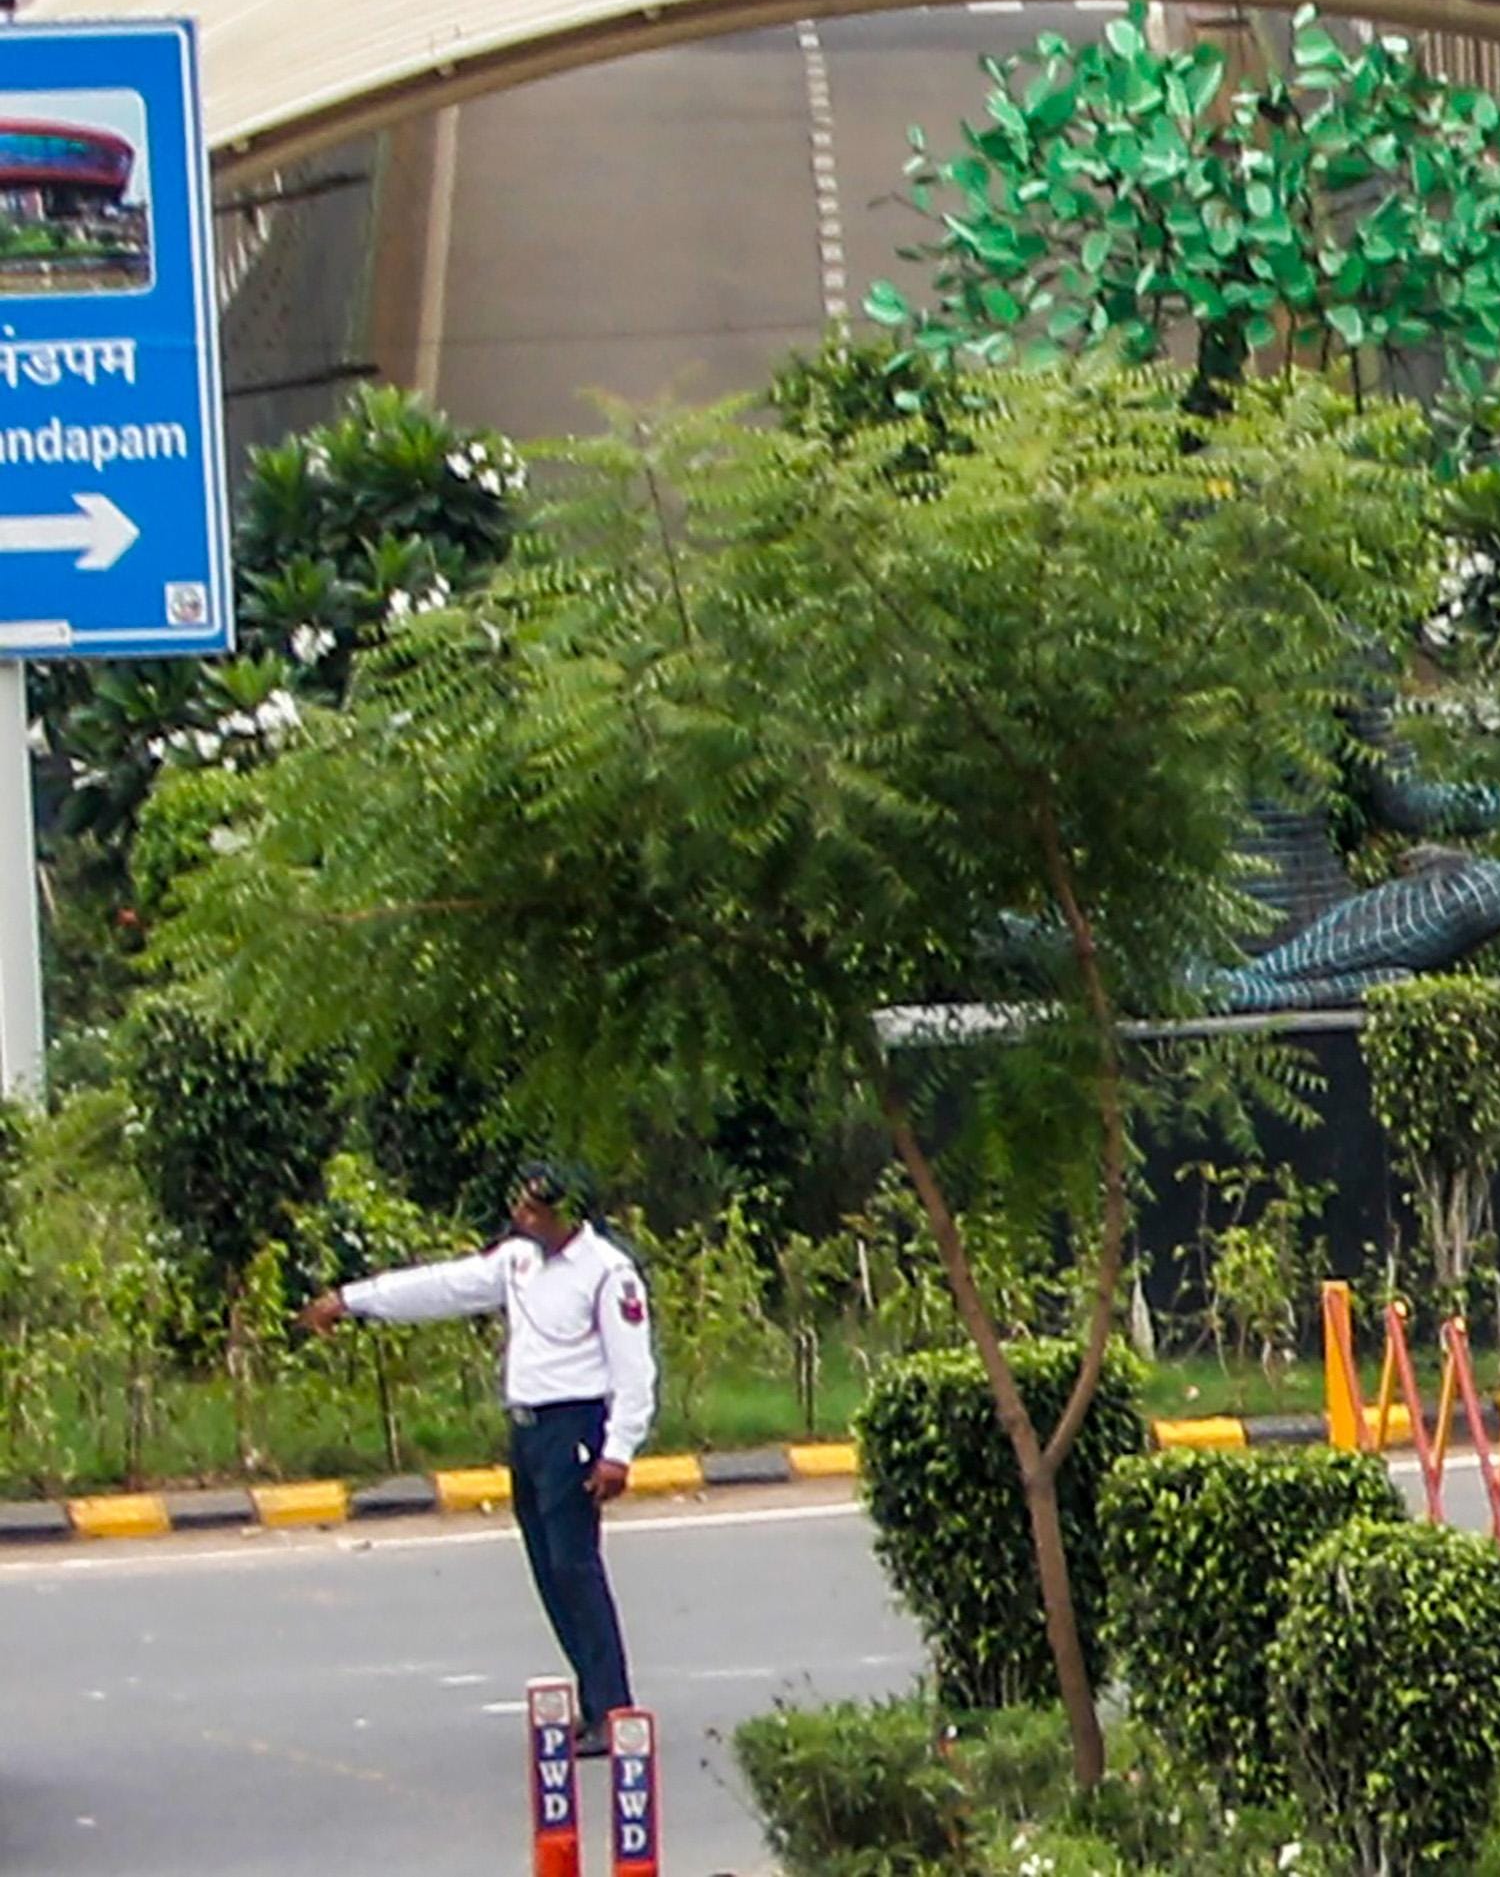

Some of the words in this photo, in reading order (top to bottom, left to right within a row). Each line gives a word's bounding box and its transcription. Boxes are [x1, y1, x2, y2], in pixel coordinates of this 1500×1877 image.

[0, 416, 188, 472] ndapam
[539, 1728, 570, 1820] PWD
[617, 1759, 648, 1853] PWD
